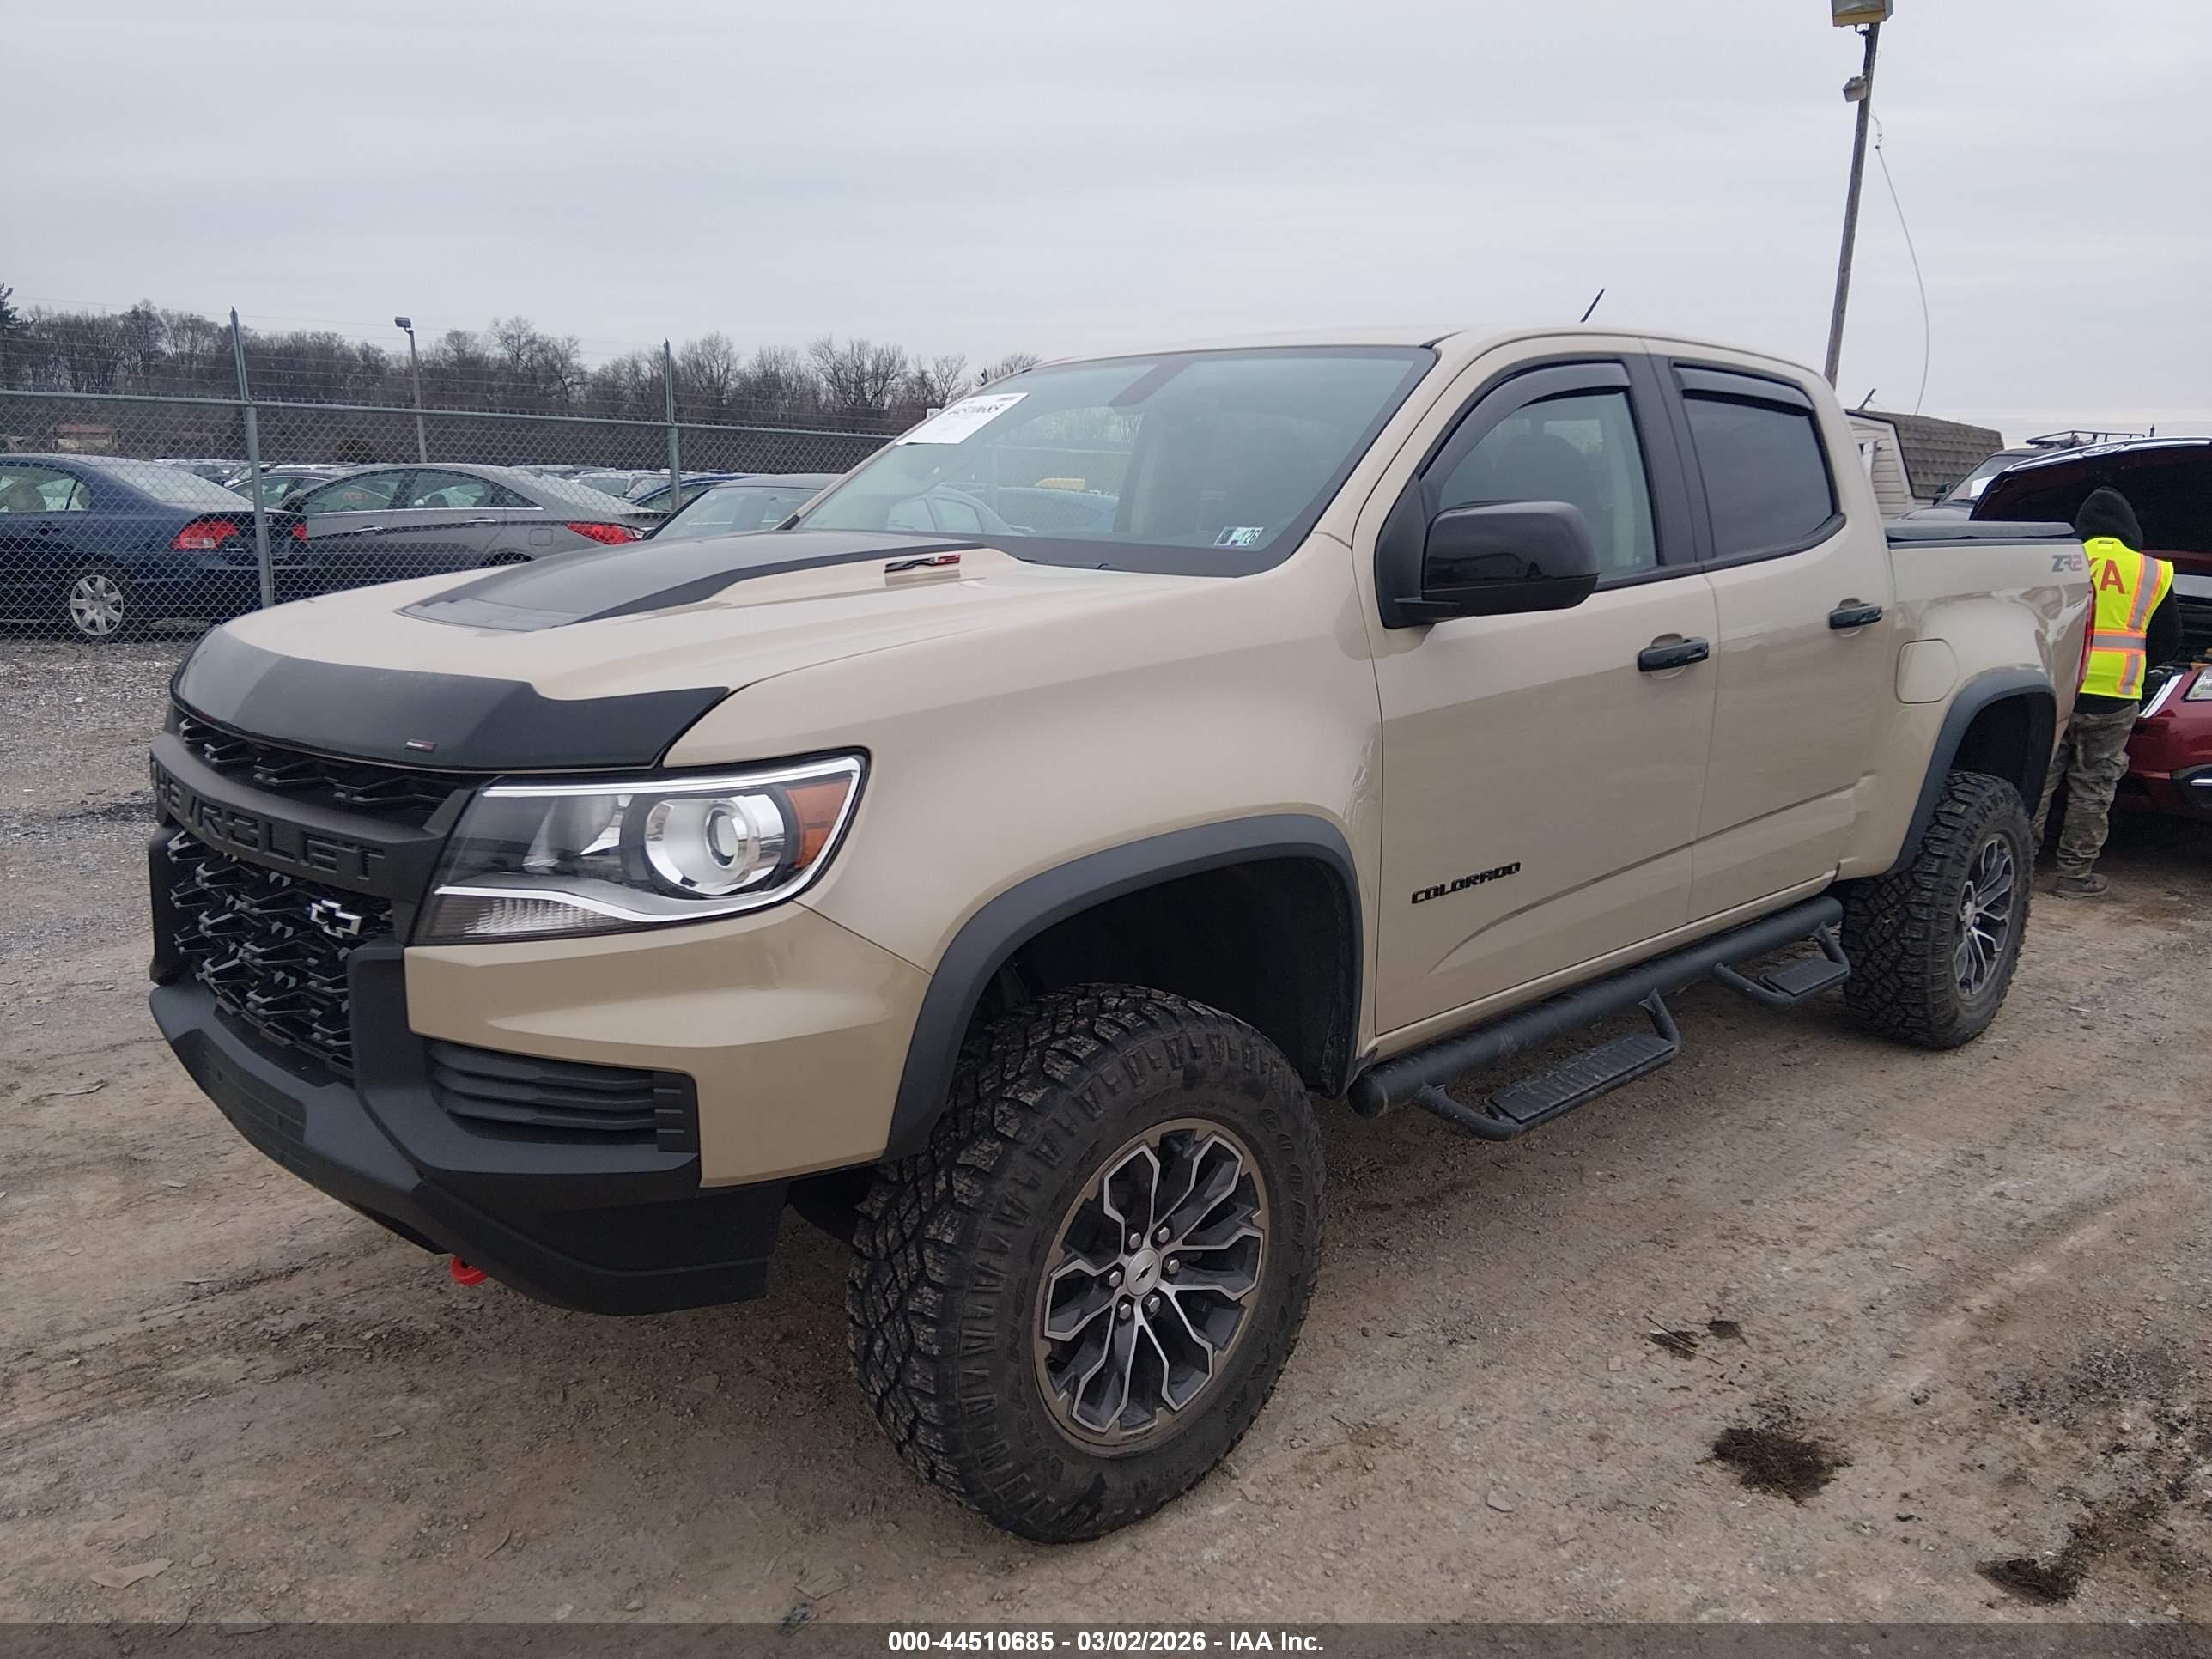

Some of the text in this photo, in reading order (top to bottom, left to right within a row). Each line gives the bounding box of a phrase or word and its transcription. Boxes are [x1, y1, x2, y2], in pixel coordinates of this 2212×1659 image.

[2051, 554, 2083, 573] ZR2
[151, 759, 386, 881] CHEVROLET
[1411, 861, 1521, 904] COLORADO
